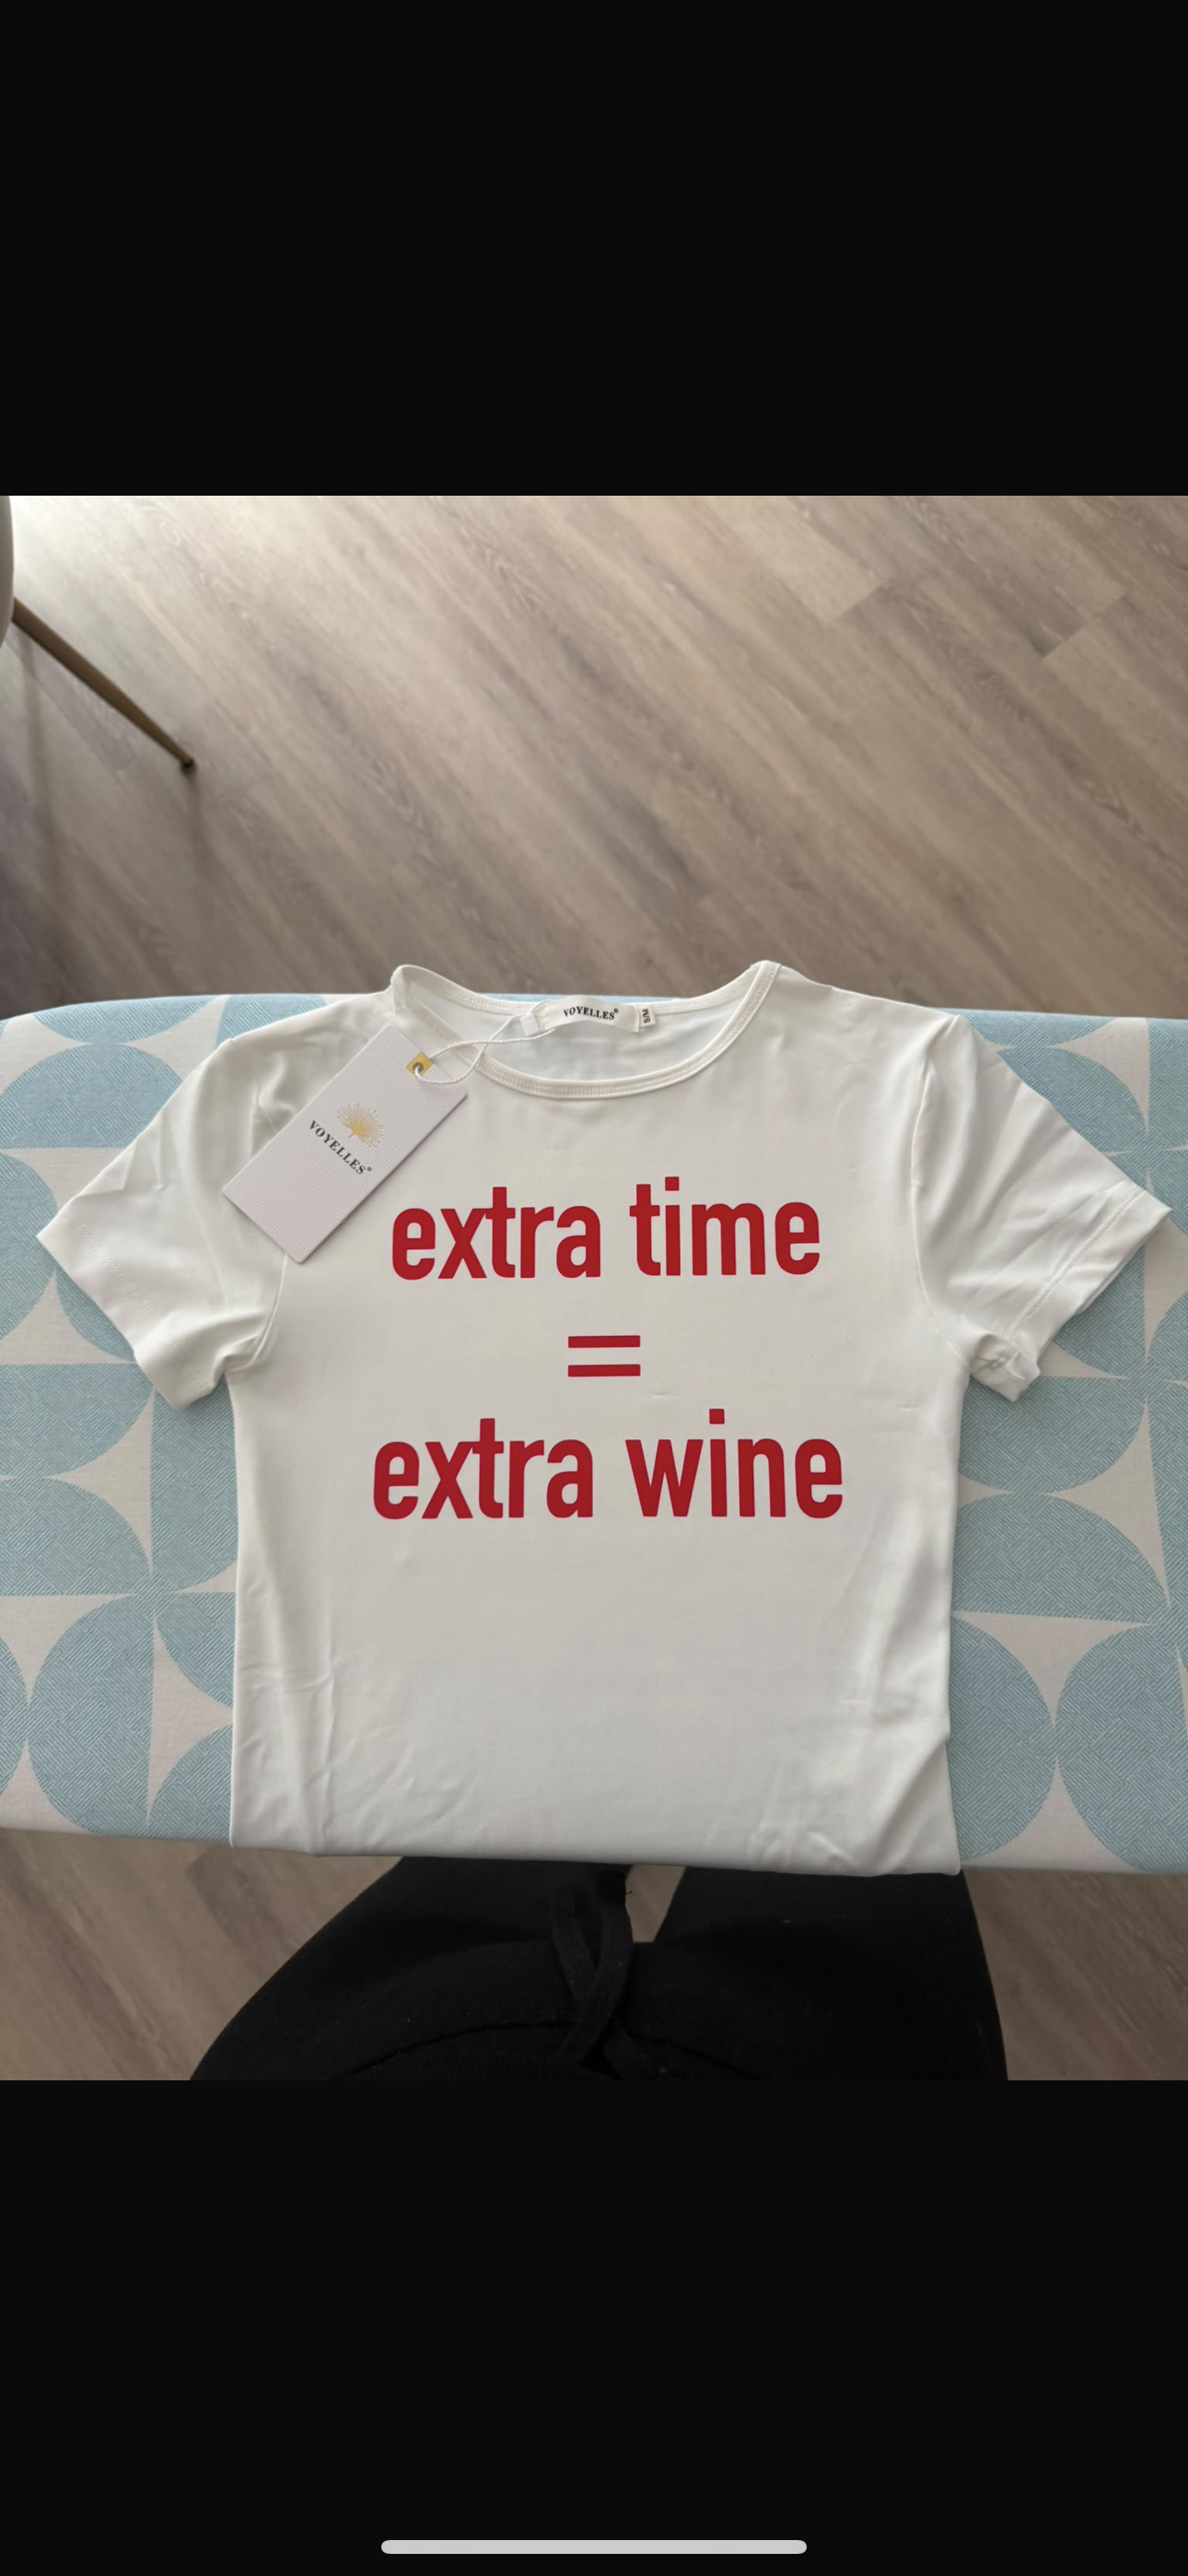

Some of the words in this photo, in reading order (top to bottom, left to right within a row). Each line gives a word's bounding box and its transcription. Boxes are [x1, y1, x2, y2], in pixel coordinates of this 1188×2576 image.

[391, 1186, 601, 1281] extra
[629, 1177, 820, 1277] time
[567, 1335, 641, 1378] =
[373, 1418, 593, 1519] extra
[625, 1409, 843, 1519] wine
